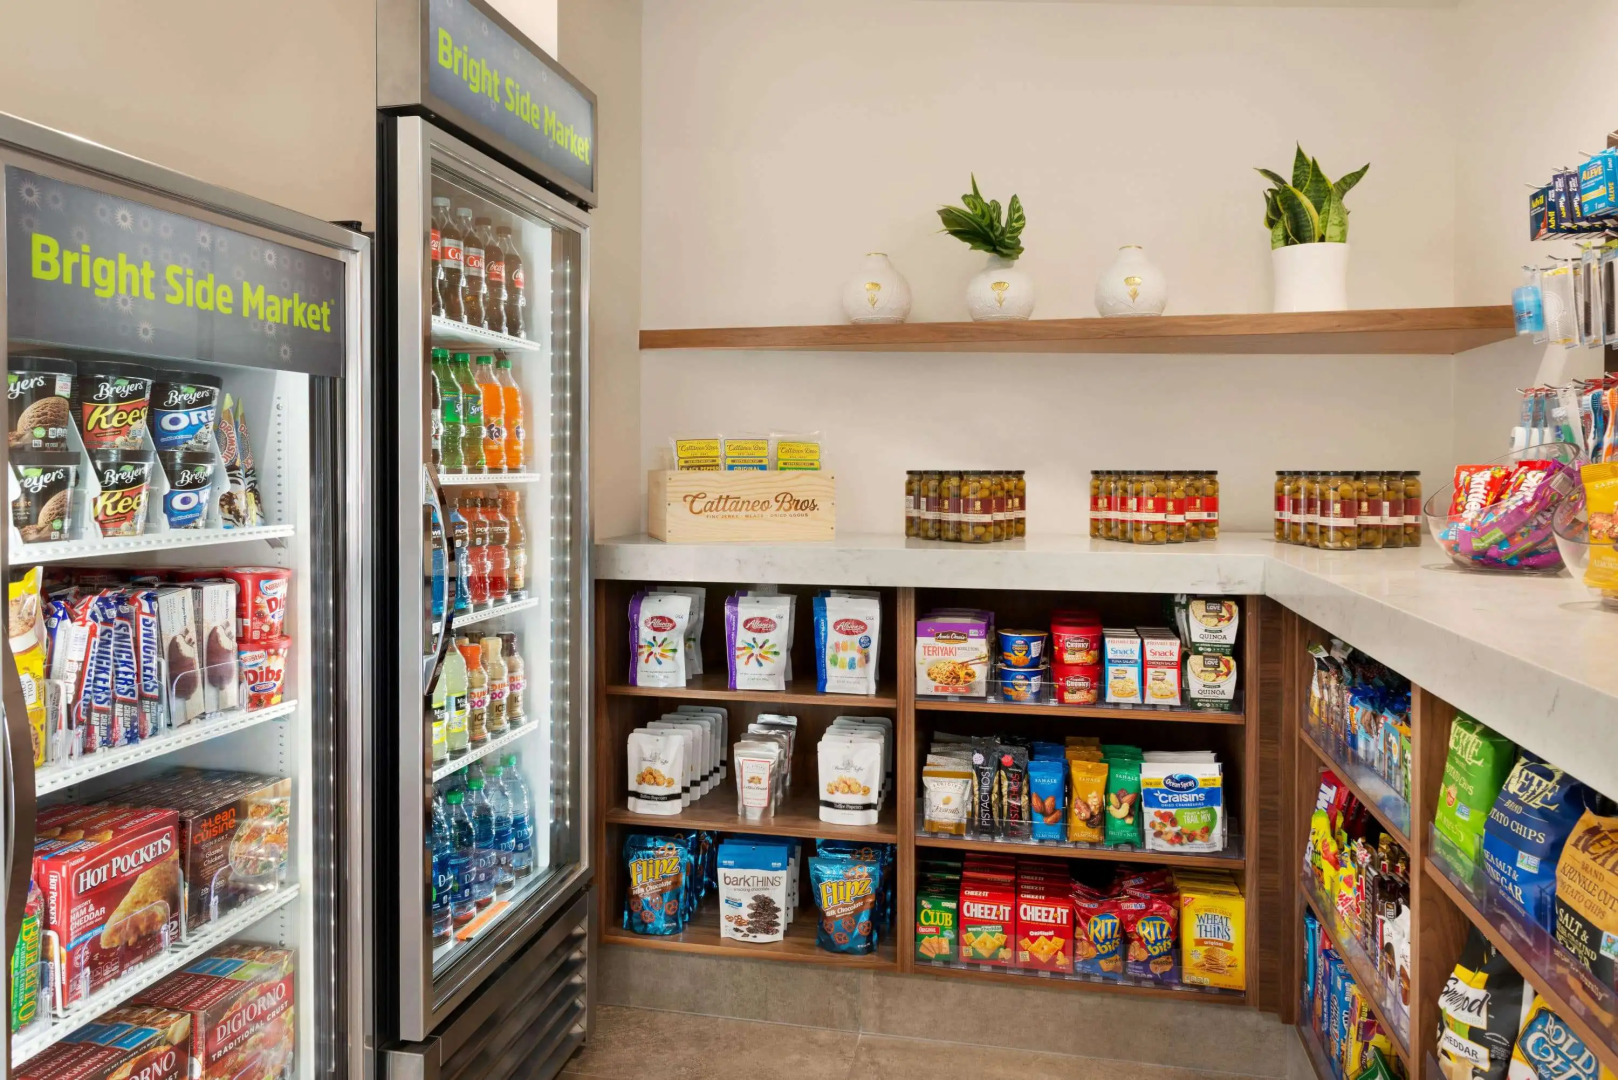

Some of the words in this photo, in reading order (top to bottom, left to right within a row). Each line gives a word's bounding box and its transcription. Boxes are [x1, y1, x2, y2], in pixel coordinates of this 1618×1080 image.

[438, 26, 500, 103] Bright
[504, 77, 540, 130] Side
[544, 106, 591, 165] Market
[1581, 166, 1603, 181] ALEVE
[1548, 211, 1556, 229] Advil
[31, 232, 155, 300] Bright
[165, 264, 233, 315] Side
[242, 281, 331, 333] Market
[8, 375, 46, 399] yers
[93, 381, 144, 400] Breyers
[164, 389, 210, 407] Breyers
[161, 409, 215, 431] ORE
[19, 467, 65, 493] reyers
[683, 492, 772, 515] Cattaneo
[774, 491, 819, 512] Bros.
[1461, 470, 1492, 520] Skittles
[1199, 633, 1227, 641] QUINOA
[114, 622, 136, 698] SNICKERS
[922, 645, 957, 657] TERIYAKI
[1111, 647, 1135, 655] Snack
[1149, 648, 1175, 657] Snack
[244, 666, 282, 686] Dibs
[100, 713, 108, 737] CREAM
[1165, 778, 1180, 788] Ocean
[1180, 780, 1195, 789] Spray
[981, 770, 991, 827] PISTACHIOS
[1009, 773, 1021, 827] PISTACHIOS
[1158, 793, 1205, 803] Craisins
[1510, 821, 1546, 844] CHIPS
[78, 863, 109, 894] HOT
[111, 832, 171, 878] POCKETS
[630, 856, 680, 888] Flipz
[1581, 860, 1605, 883] BRAND
[49, 874, 58, 893] HOT
[646, 880, 672, 891] Chocolate
[723, 873, 781, 887] barkTHINS
[1560, 862, 1599, 898] KRINKLE
[1598, 889, 1618, 913] CUT
[820, 878, 872, 910] Flipz
[49, 893, 58, 925] POCKETS
[70, 907, 87, 921] HAM
[88, 903, 95, 913] &
[70, 906, 106, 931] CHEDDAR
[837, 901, 864, 914] Chocolate
[920, 909, 953, 927] CLUB
[1195, 912, 1231, 926] WHEAT
[1089, 917, 1119, 942] RITZ
[1138, 919, 1170, 944] RITZ
[1558, 908, 1582, 937] SALT
[1580, 931, 1590, 944] &
[1096, 939, 1120, 954] bits
[1147, 940, 1172, 956] bits
[19, 919, 39, 1021] BURRITO
[216, 982, 286, 1043] DIGIORNO
[212, 1019, 265, 1061] TRADITIONAL
[266, 1000, 288, 1022] CRUST
[1544, 1012, 1597, 1075] ROLD
